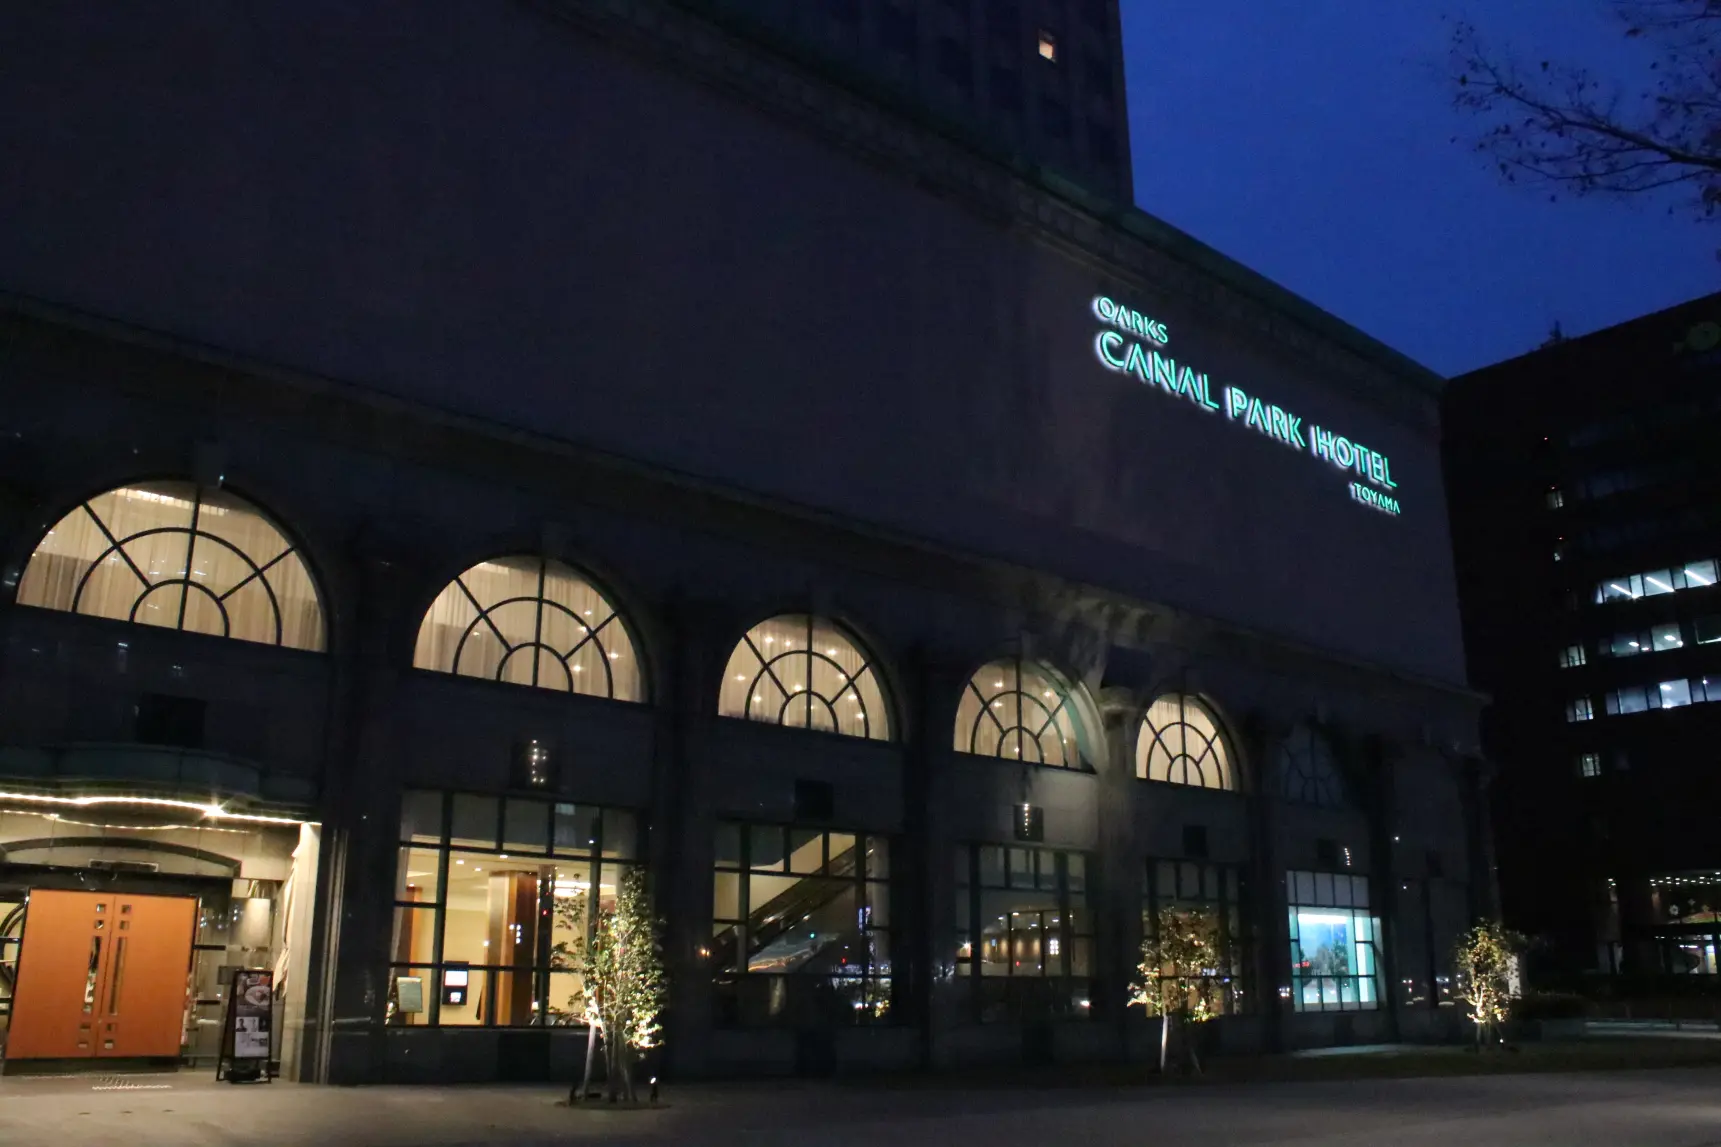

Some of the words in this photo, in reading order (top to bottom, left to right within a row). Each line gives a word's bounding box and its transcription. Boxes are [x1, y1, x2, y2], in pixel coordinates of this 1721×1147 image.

[1100, 331, 1219, 409] CANAL
[1229, 386, 1305, 447] PARK
[1313, 425, 1397, 487] HOTEL
[1352, 482, 1400, 513] TOYAMA
